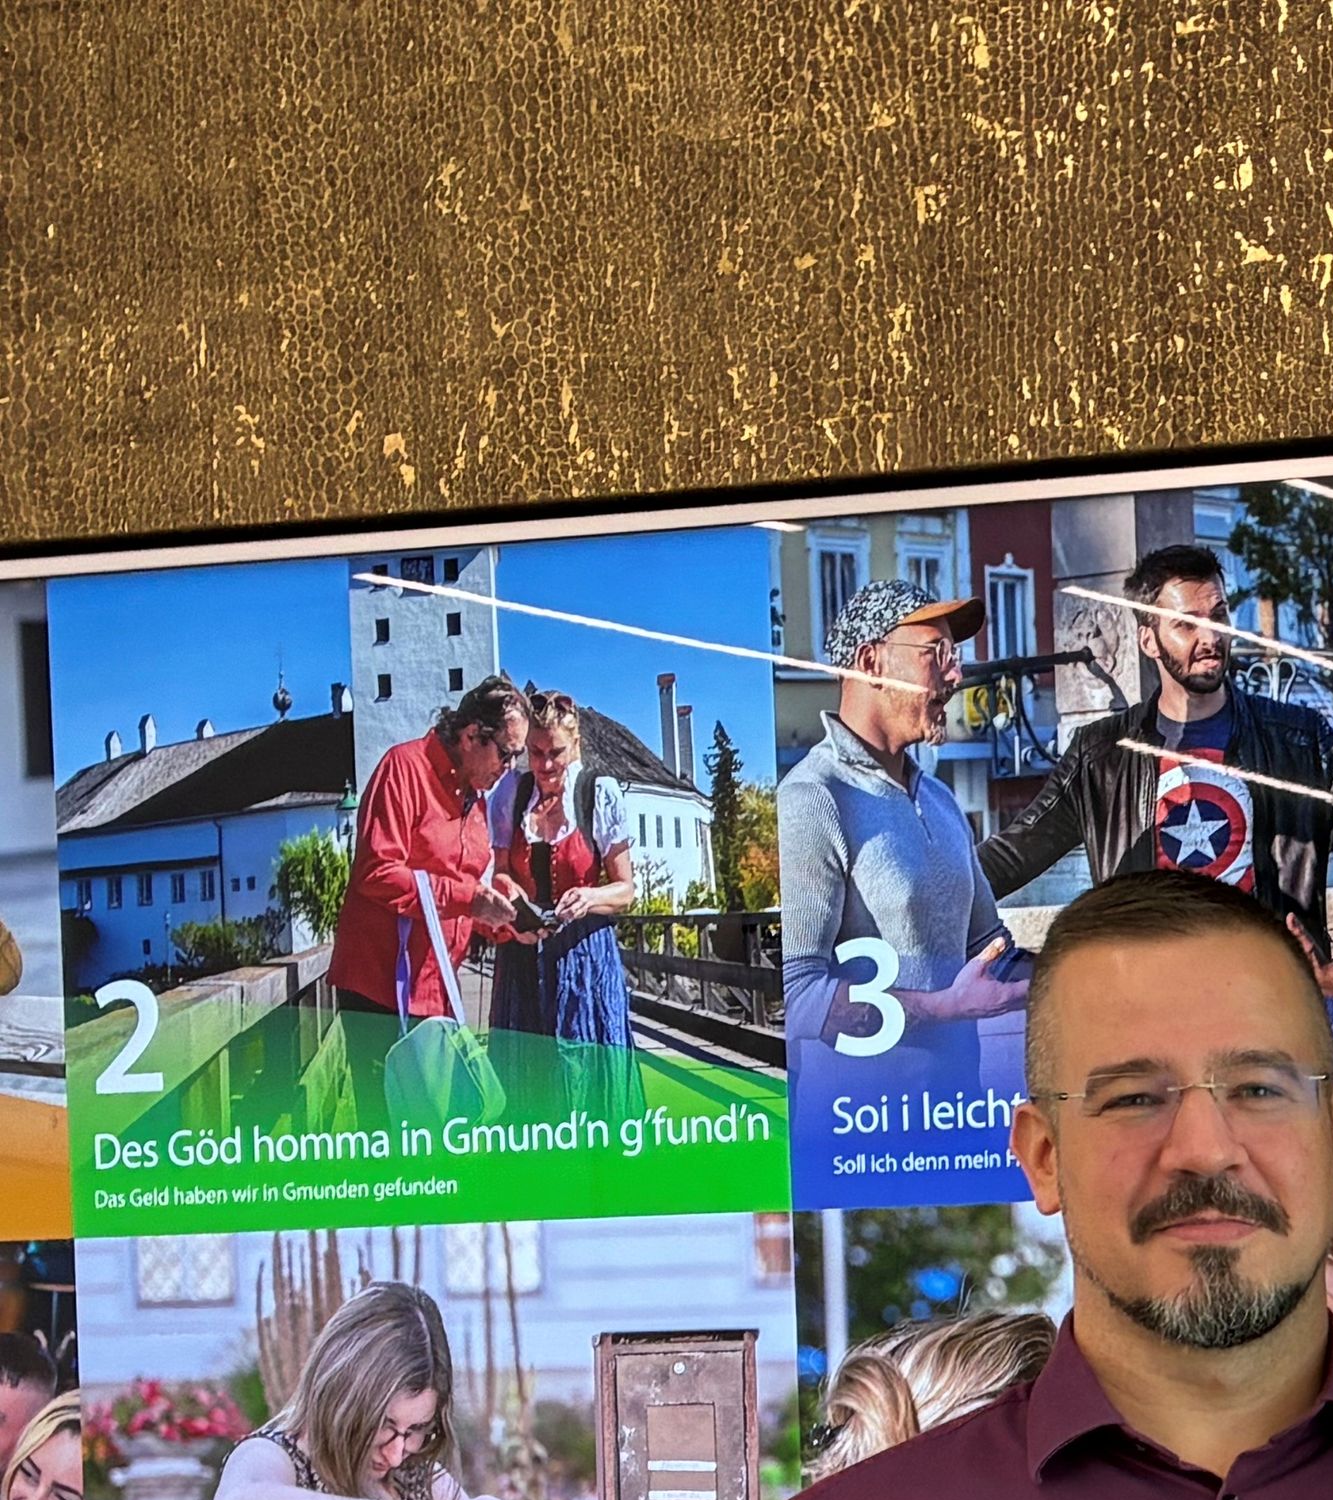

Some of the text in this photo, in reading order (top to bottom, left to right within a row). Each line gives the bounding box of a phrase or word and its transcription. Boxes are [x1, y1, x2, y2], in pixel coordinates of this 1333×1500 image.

[834, 936, 905, 1057] 3
[94, 979, 164, 1095] 2
[94, 1103, 769, 1170] Des Göd homma in Gmund'n g'fund'n
[833, 1095, 888, 1134] Soi
[901, 1094, 909, 1131] i
[833, 1153, 866, 1175] Soll
[902, 1152, 949, 1171] denn
[954, 1150, 1001, 1170] mein
[94, 1176, 458, 1209] Das Geld haben wir in Gmunden gefunden
